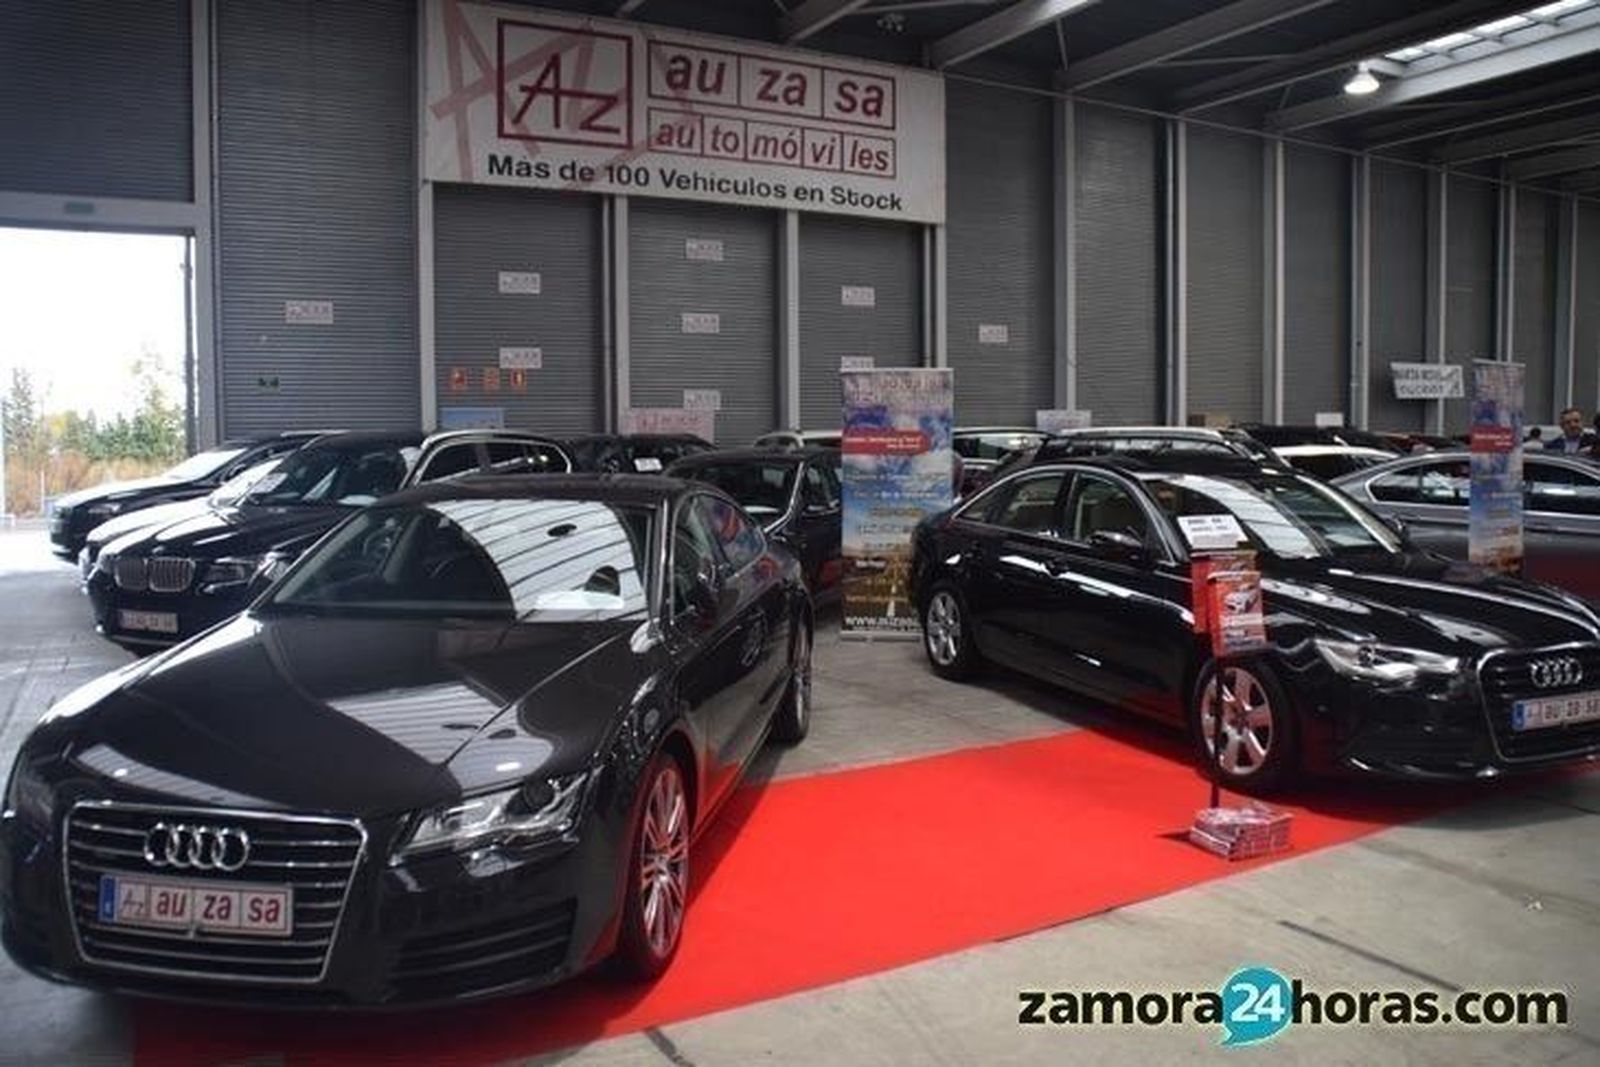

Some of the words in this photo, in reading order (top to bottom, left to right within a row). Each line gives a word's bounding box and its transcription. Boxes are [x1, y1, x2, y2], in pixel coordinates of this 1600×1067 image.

[559, 160, 595, 183] de
[606, 165, 650, 188] 100
[794, 184, 825, 205] en
[830, 186, 903, 211] Stock
